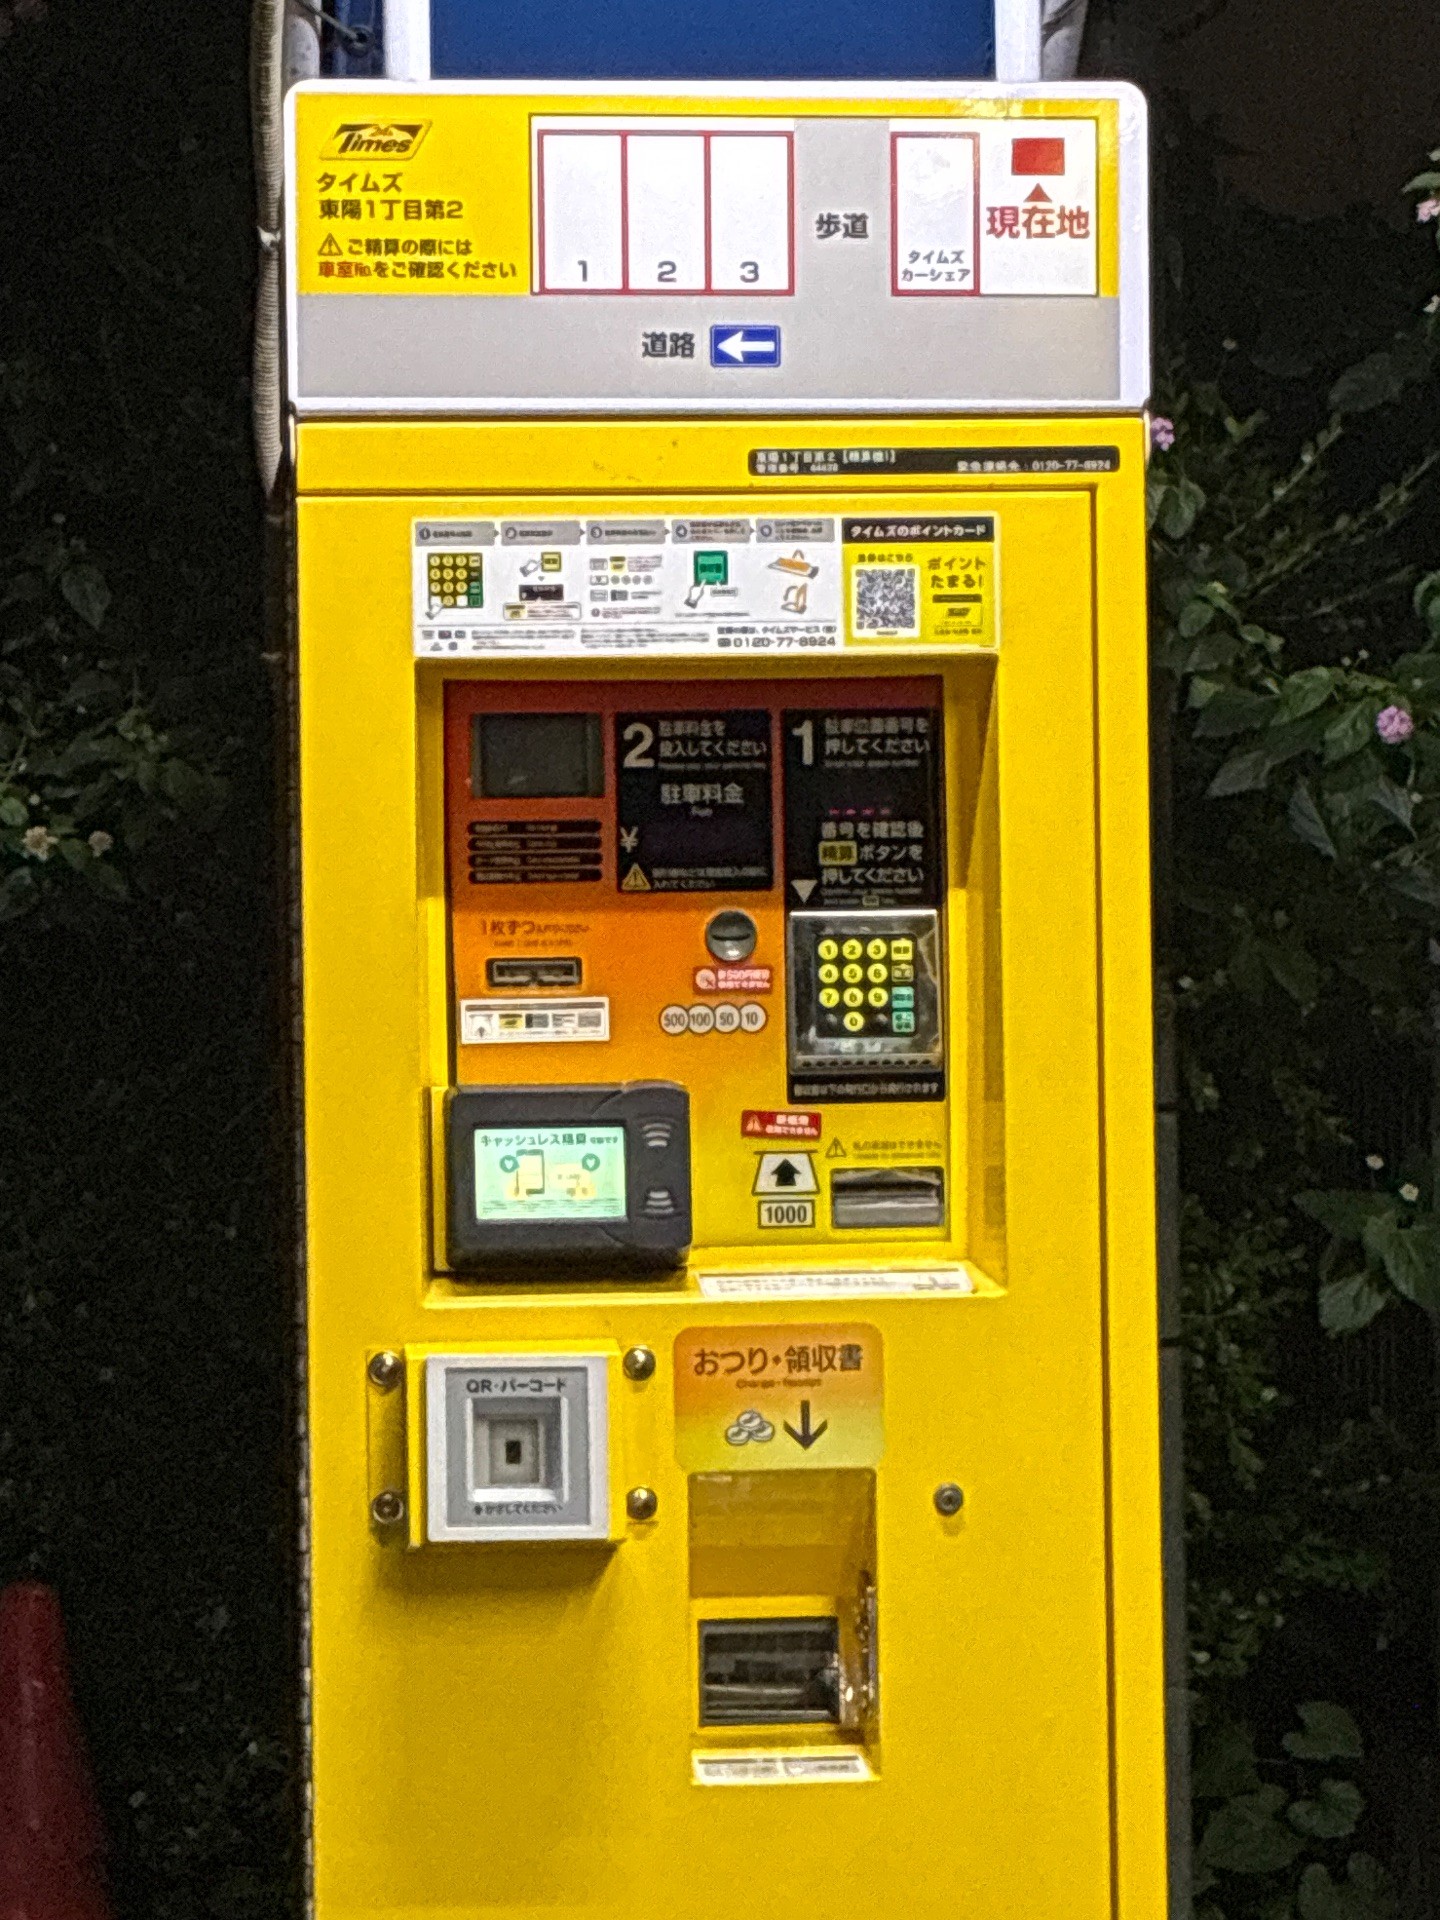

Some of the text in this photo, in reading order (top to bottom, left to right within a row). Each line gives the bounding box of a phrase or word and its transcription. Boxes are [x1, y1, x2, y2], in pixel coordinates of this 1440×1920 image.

[338, 132, 413, 154] Times
[317, 172, 404, 193] タイムズ
[319, 199, 464, 221] 東陽1丁目第2
[815, 212, 869, 239] 歩道
[985, 205, 1091, 240] 現在地
[348, 238, 473, 256] ご精算の際には
[907, 249, 966, 266] タイムズ
[577, 260, 589, 282] 1
[657, 260, 678, 282] 2
[739, 261, 760, 283] 3
[901, 267, 971, 283] カーシェア
[641, 330, 696, 359] 道路
[850, 524, 987, 539] タイムズのポイントカード
[927, 556, 986, 571] ポイント
[622, 722, 655, 768] 2
[791, 720, 814, 766] 1
[824, 738, 931, 755] 押してください
[859, 843, 924, 862] ボタンを
[821, 867, 925, 886] 押してください
[663, 1013, 685, 1027] 500
[691, 1013, 711, 1026] 100
[720, 1013, 734, 1026] 50
[745, 1012, 758, 1025] 10
[764, 1205, 808, 1224] 1000
[694, 1343, 864, 1376] おつり・領収書
[466, 1378, 568, 1393] QR・バーコード
